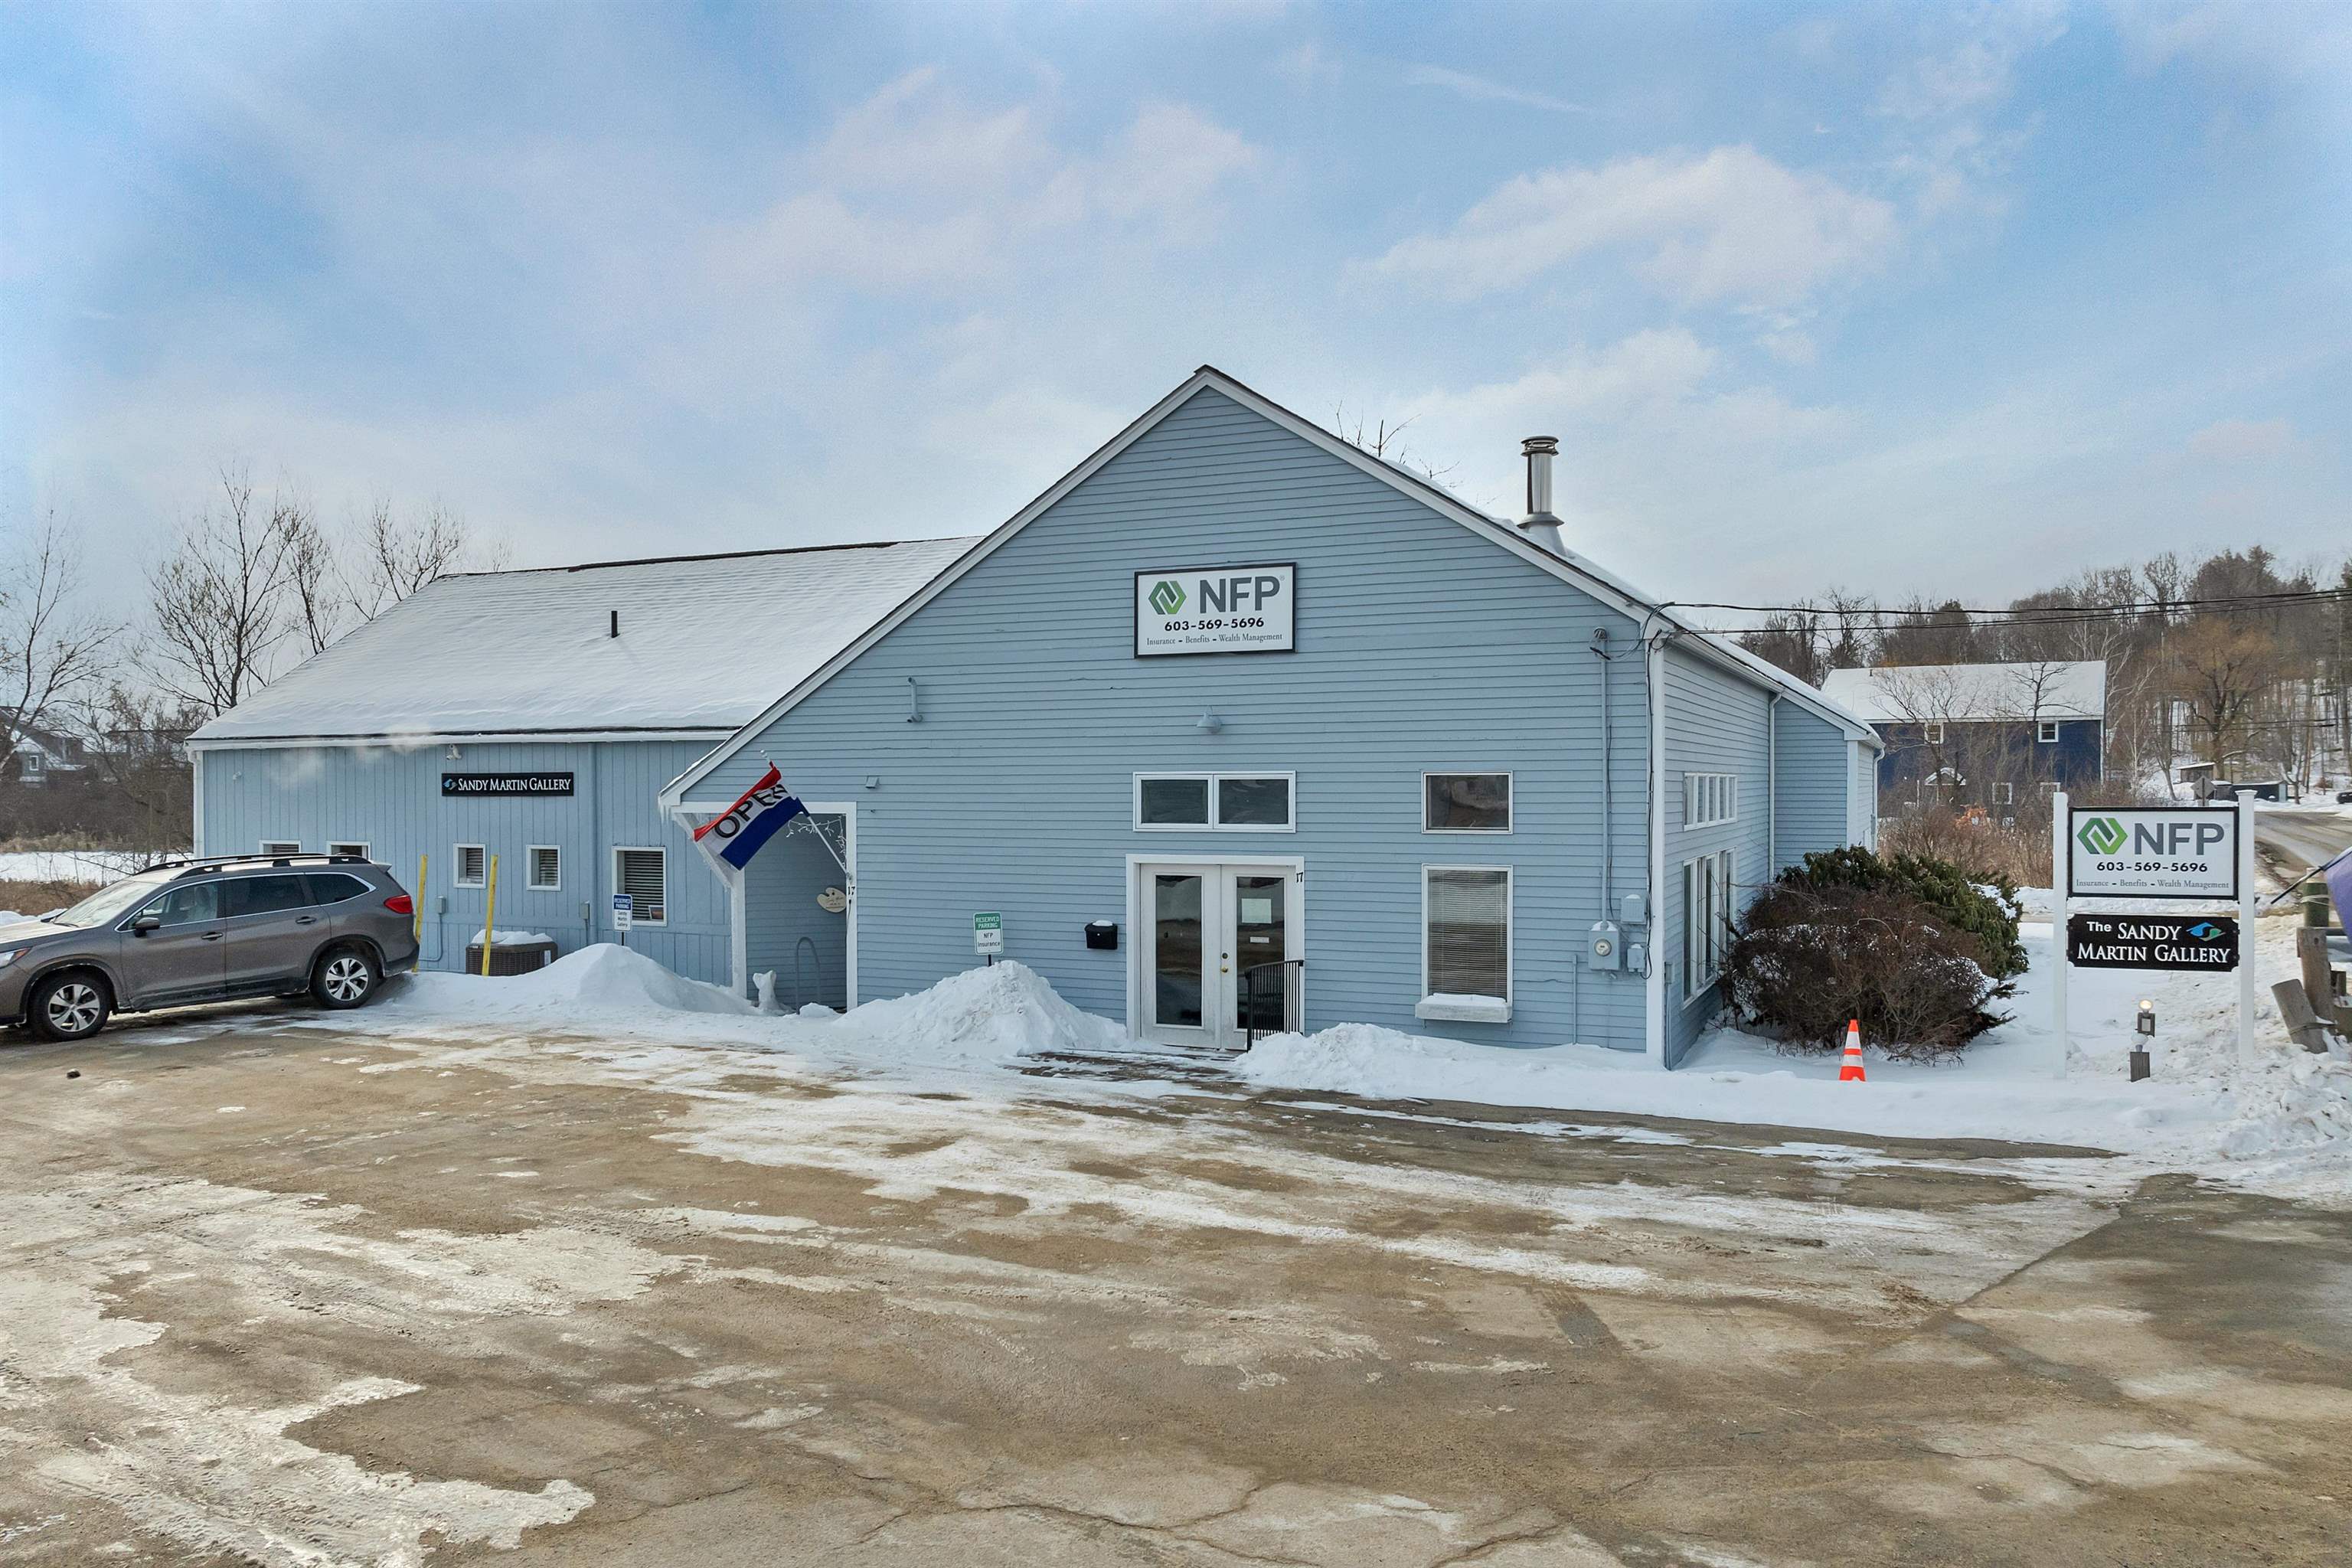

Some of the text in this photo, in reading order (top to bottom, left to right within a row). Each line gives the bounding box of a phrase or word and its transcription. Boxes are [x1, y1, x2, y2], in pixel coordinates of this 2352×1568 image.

[1165, 617, 1264, 632] 603-569-5696
[1185, 635, 1210, 644] Benefits
[1219, 634, 1240, 642] Wealth
[1242, 633, 1282, 643] Management
[458, 777, 571, 791] SANDY MARTIN GALLERY
[2096, 862, 2208, 872] 603-569-5696
[1296, 872, 1303, 882] 17
[2184, 880, 2229, 890] Management
[2086, 921, 2182, 940] The SANDY
[2077, 942, 2230, 963] MARTIN GALLERY
